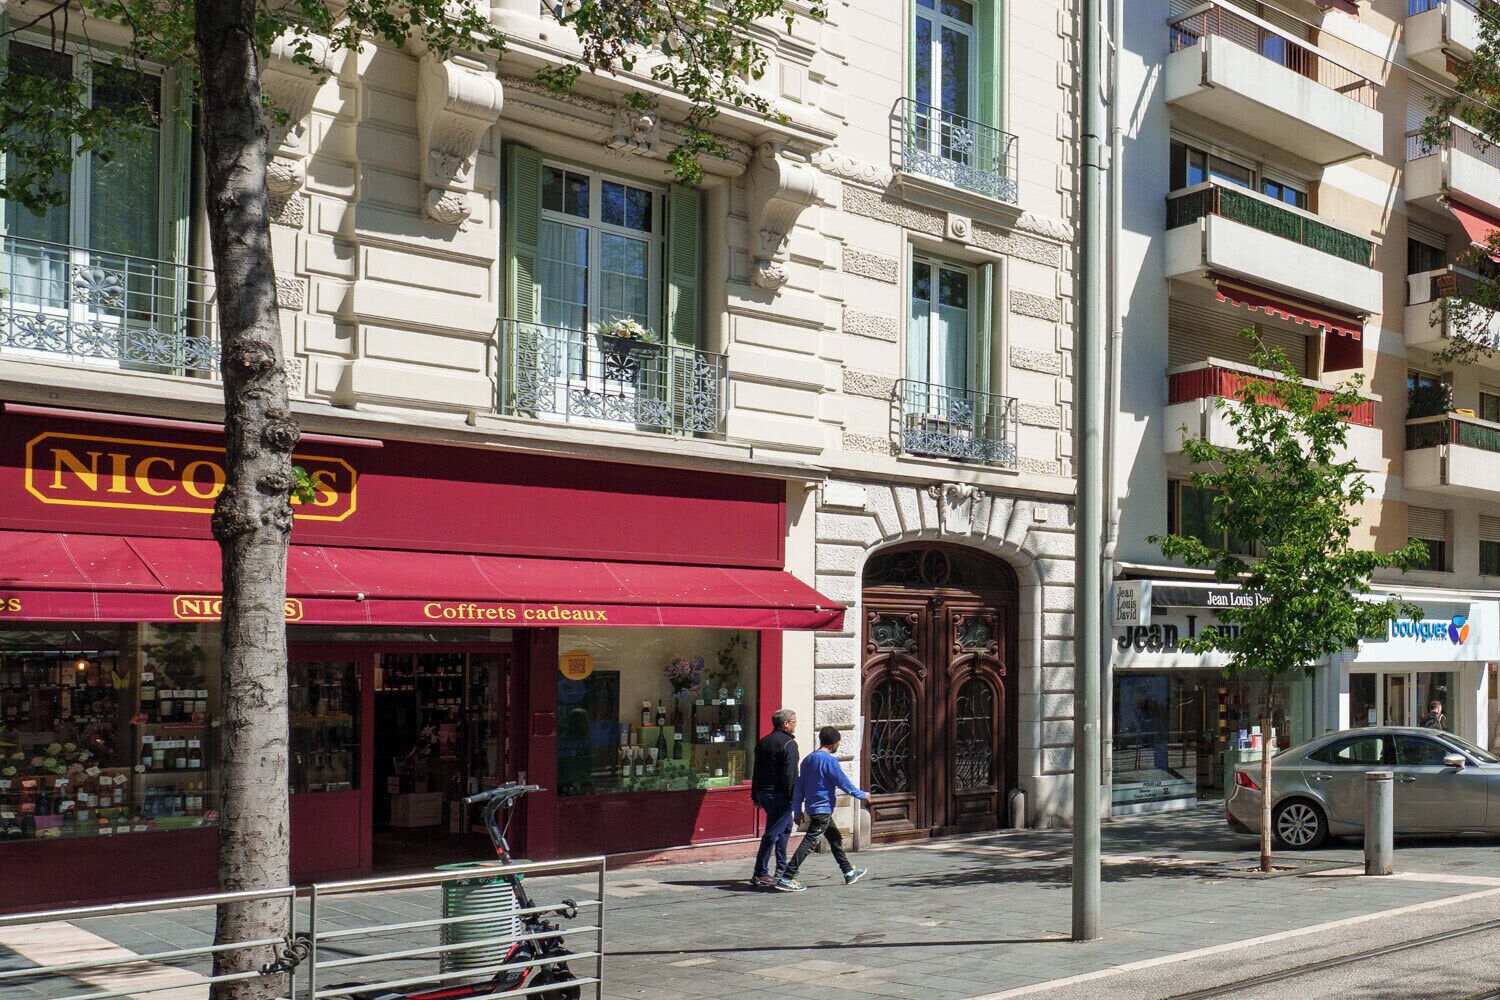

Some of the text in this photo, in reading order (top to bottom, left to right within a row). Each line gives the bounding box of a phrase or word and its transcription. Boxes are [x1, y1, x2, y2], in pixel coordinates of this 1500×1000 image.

[49, 448, 339, 508] NICOS
[1117, 587, 1133, 597] Jean
[1207, 592, 1274, 607] Jean Louis Dav
[181, 600, 297, 617] NICS
[424, 603, 608, 621] Coffrets cadeaux
[1117, 598, 1137, 609] Louis
[1117, 609, 1137, 620] David
[1118, 623, 1178, 649] Jean
[1391, 620, 1448, 643] bouygues
